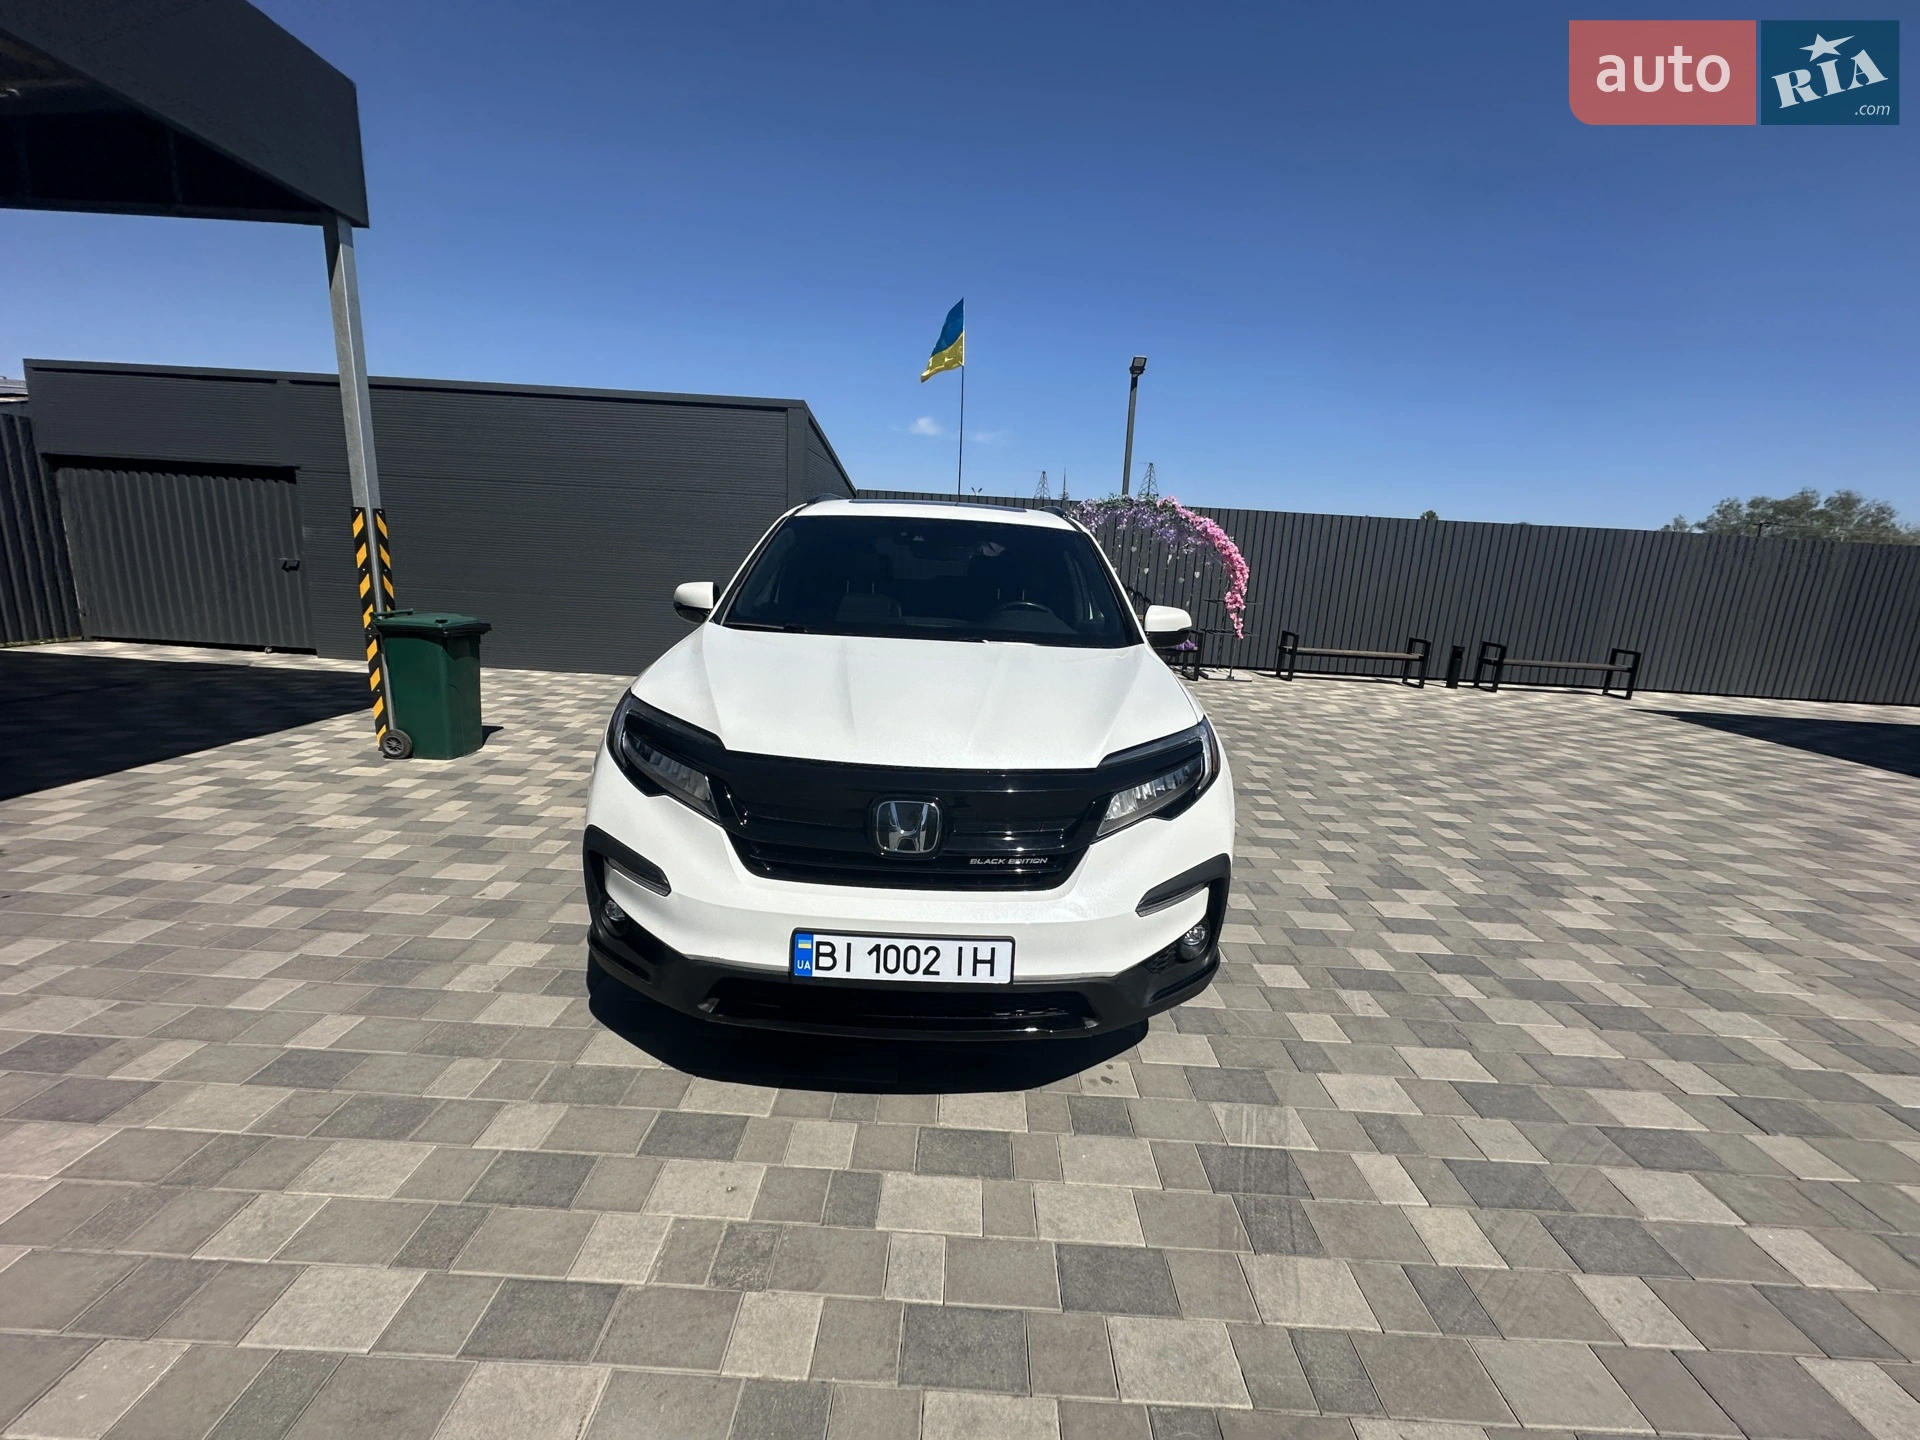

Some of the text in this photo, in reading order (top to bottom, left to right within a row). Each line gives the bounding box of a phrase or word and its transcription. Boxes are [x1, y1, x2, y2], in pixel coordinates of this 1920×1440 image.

[1007, 857, 1048, 865] EDITION
[814, 940, 996, 977] BI 1002 IH
[797, 959, 811, 970] UA
